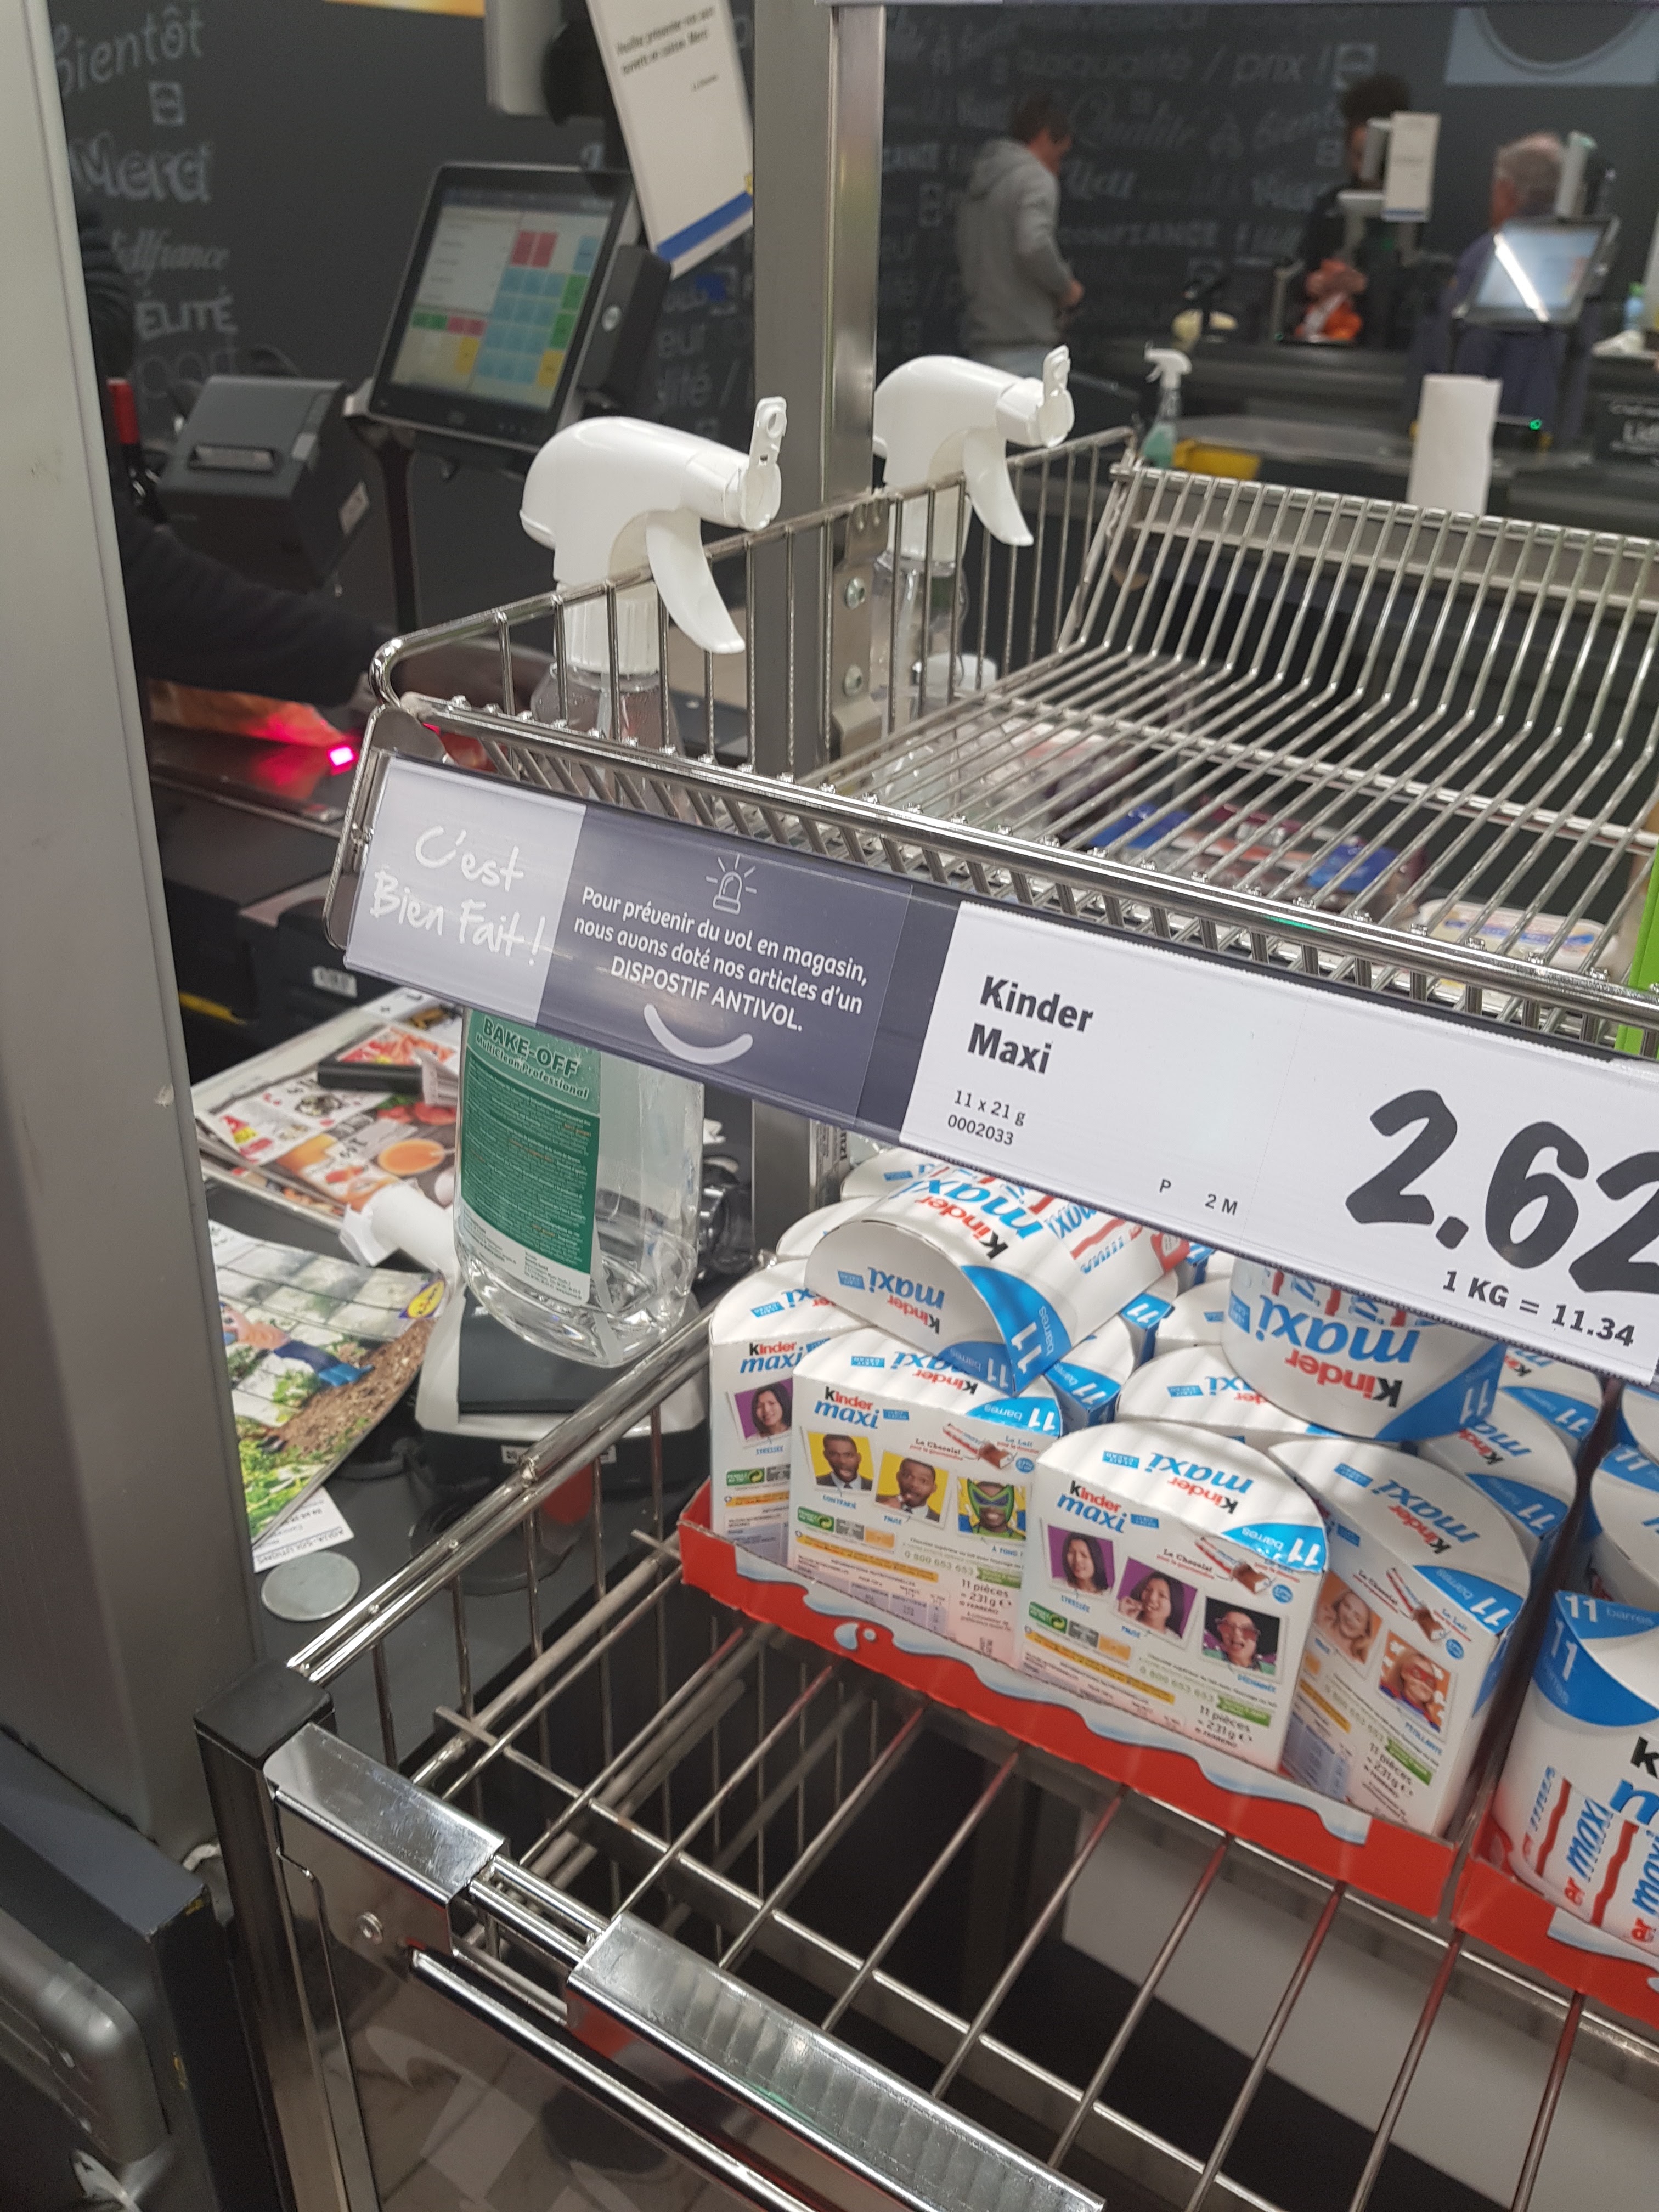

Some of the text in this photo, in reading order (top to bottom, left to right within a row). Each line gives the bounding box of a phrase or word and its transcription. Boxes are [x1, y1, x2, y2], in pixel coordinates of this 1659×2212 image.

[415, 825, 524, 892] C'est
[369, 871, 444, 936] Bien
[582, 885, 868, 987] Pour prévenir du vol en magasin,
[574, 916, 614, 944] nous
[617, 932, 669, 958] avons
[670, 940, 710, 972] doté
[713, 956, 745, 980] nos
[748, 966, 818, 1002] articles
[610, 955, 804, 1032] DISPOSTIF ANTIVOL.
[979, 974, 1094, 1034] Kinder
[967, 1023, 1053, 1075] Maxi
[953, 1089, 1026, 1127] 11 x 21 g
[947, 1114, 1014, 1146] 0002033
[1159, 1178, 1239, 1217] P 2 M
[1345, 1089, 1659, 1295] 2.62
[867, 1267, 945, 1310] maxi
[1128, 1304, 1159, 1324] 11
[1255, 1294, 1421, 1364] maxi
[1442, 1271, 1458, 1293] 1
[1467, 1277, 1510, 1309] KG
[1550, 1304, 1636, 1348] 11.34
[740, 1347, 804, 1374] maxi
[891, 1350, 968, 1373] axi
[986, 1357, 1009, 1389] 11
[1071, 1382, 1108, 1406] 11
[814, 1400, 879, 1429] maxi
[984, 1404, 1056, 1431] barres 11
[1555, 1408, 1591, 1434] 11
[1144, 1452, 1255, 1494] maxi
[1614, 1446, 1651, 1471] 11
[1056, 1492, 1128, 1533] maxi
[1371, 1479, 1481, 1544] maxi
[1517, 1503, 1556, 1530] 11
[1241, 1527, 1321, 1567] barres 11
[1470, 1596, 1511, 1627] 11
[1565, 1595, 1598, 1623] 11
